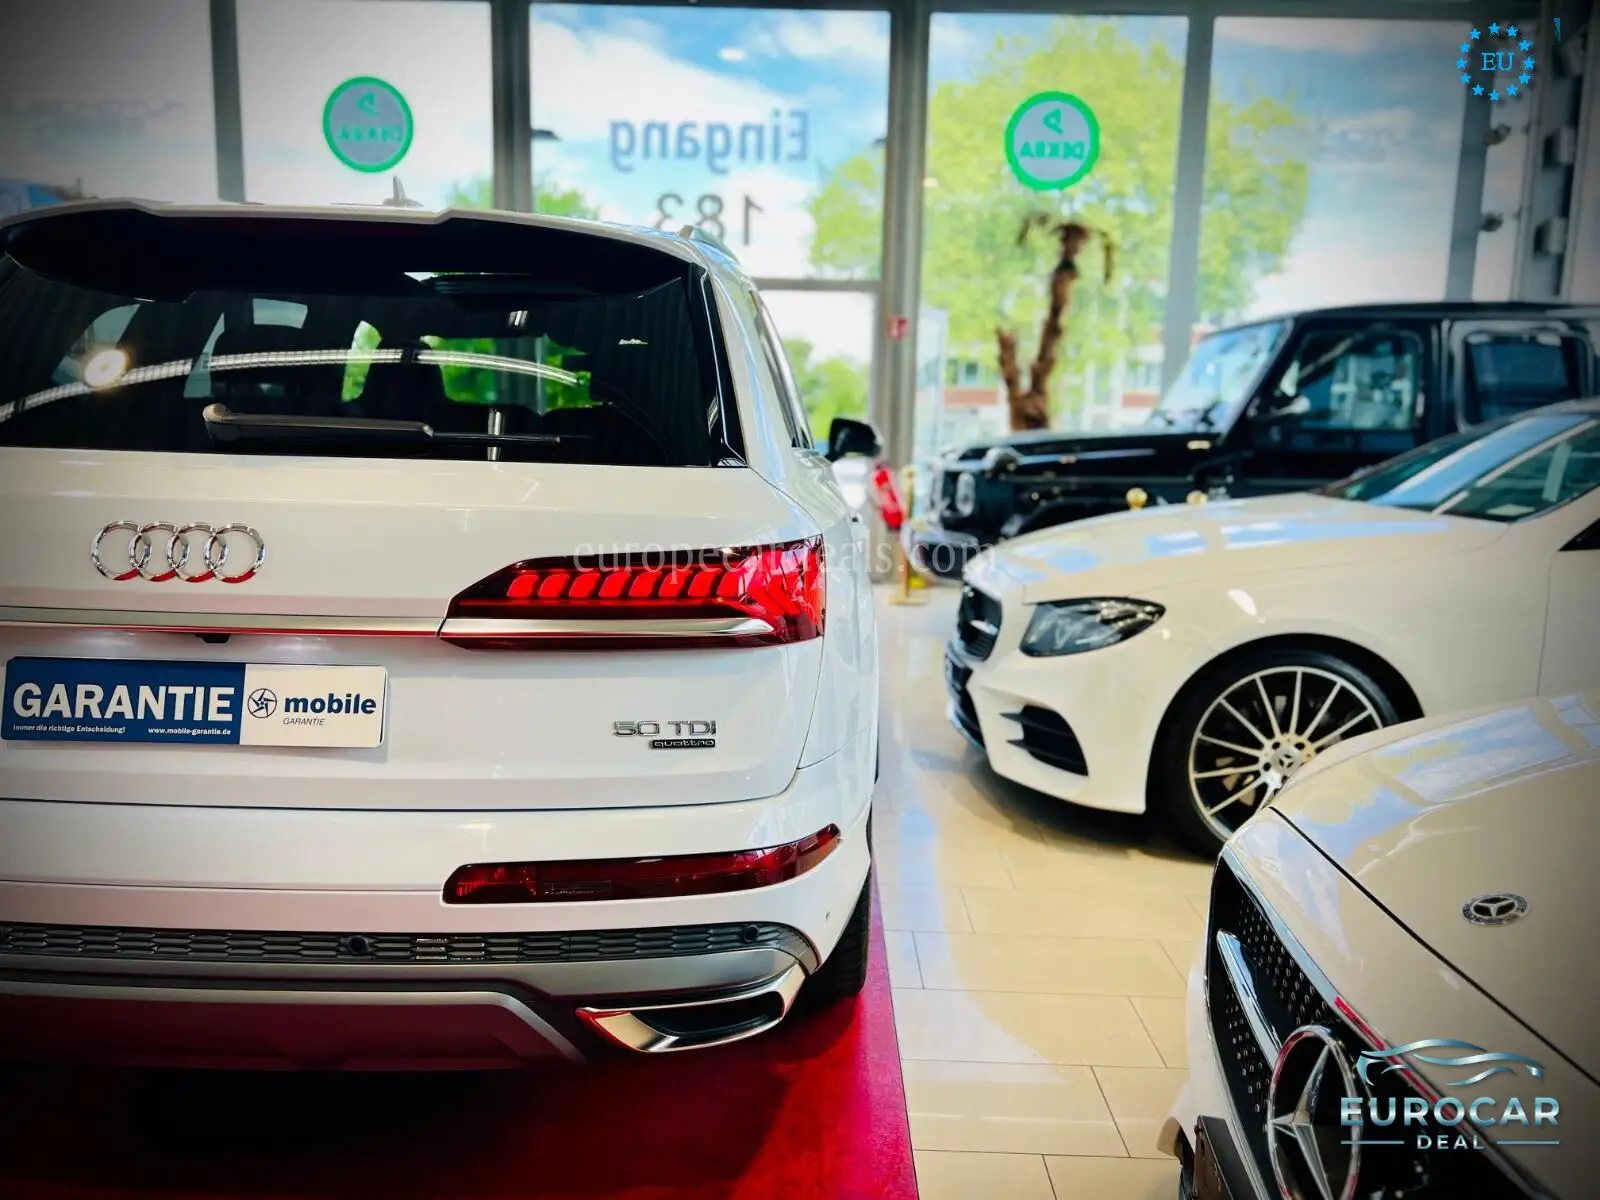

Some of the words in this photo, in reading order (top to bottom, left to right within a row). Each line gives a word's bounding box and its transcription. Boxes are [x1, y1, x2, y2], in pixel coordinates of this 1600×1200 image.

[13, 682, 235, 721] GARANTIE
[284, 693, 377, 715] mobile
[283, 717, 326, 726] GARANTIE
[48, 725, 75, 733] richtige
[76, 725, 125, 734] Entscheidung!
[148, 727, 232, 736] www.mobile-garantie.de
[613, 720, 660, 736] 50
[667, 720, 716, 736] TDI
[654, 740, 714, 748] quattro
